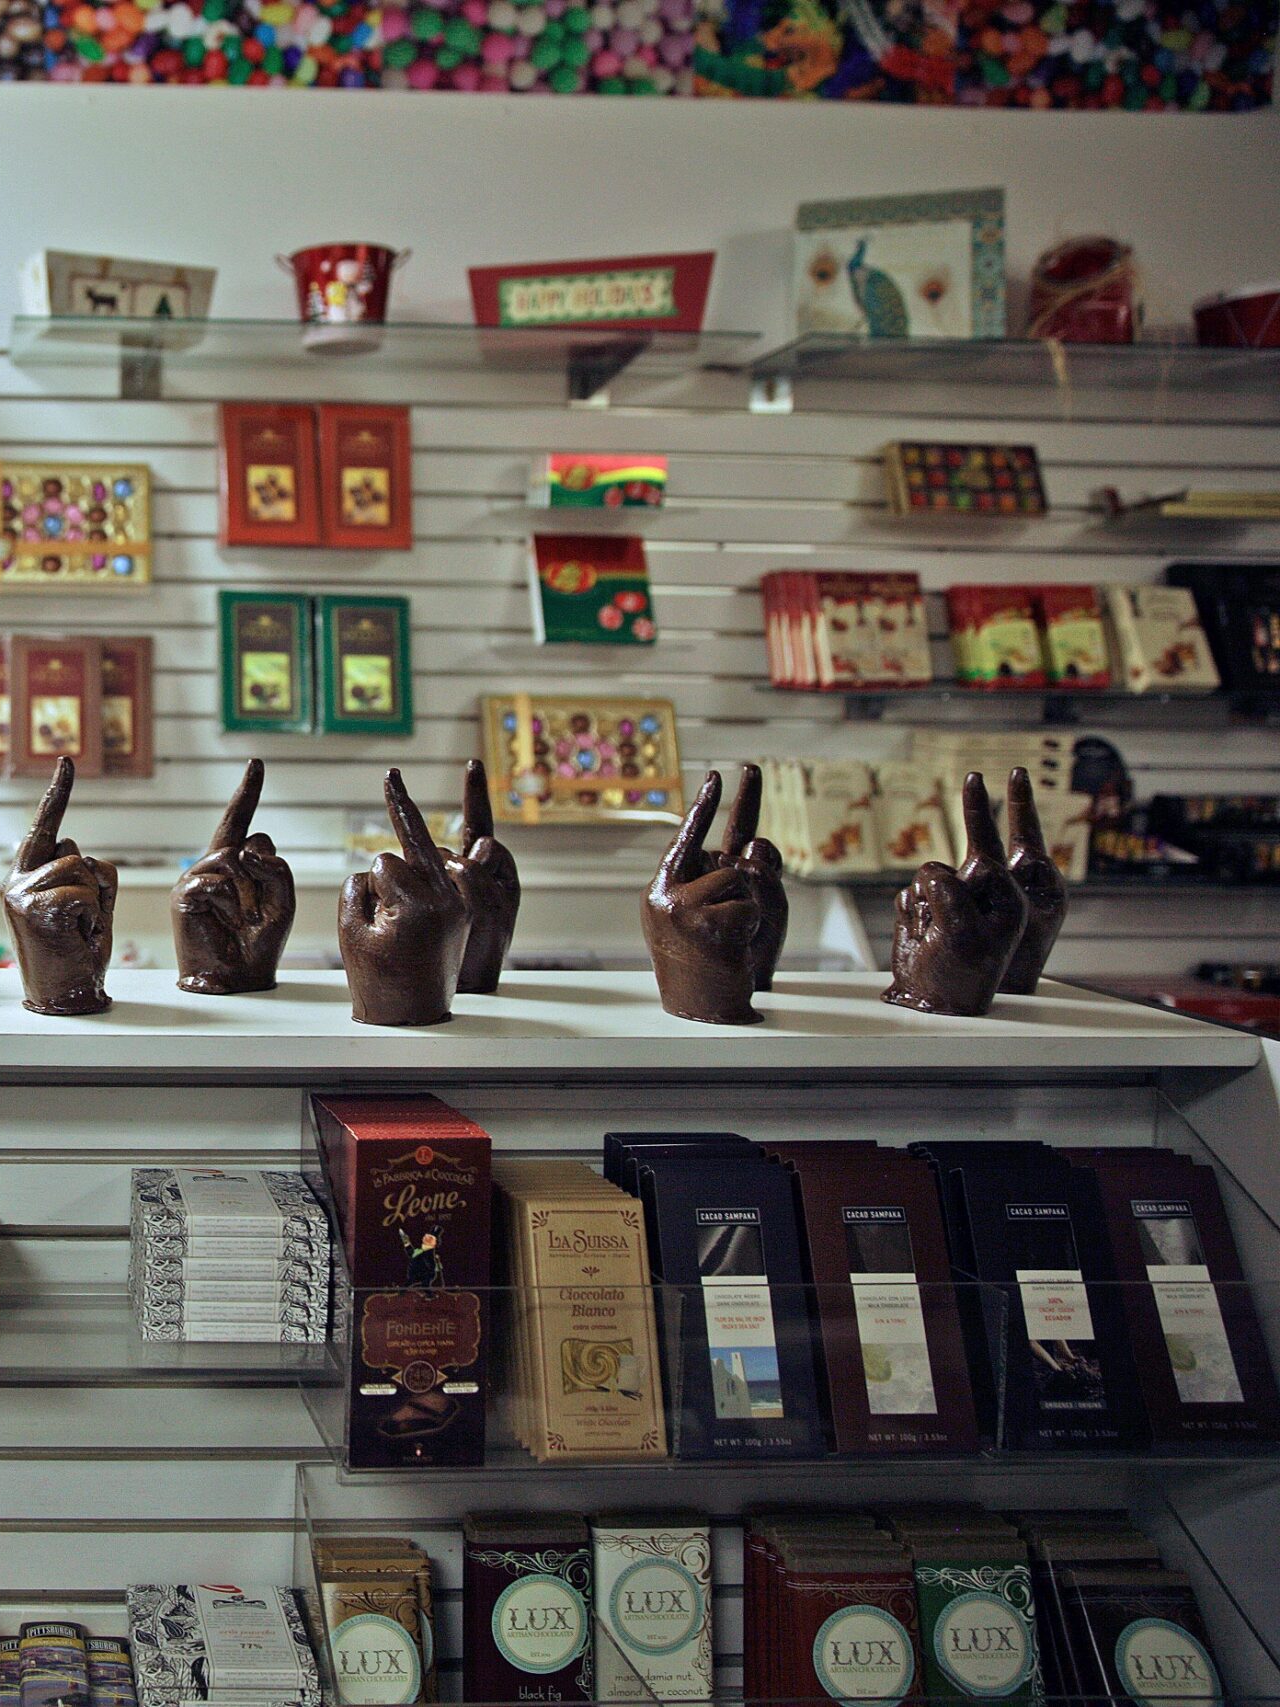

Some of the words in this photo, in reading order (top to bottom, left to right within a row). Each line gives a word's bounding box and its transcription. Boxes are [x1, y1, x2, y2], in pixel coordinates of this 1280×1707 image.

[382, 1184, 467, 1227] Leone
[700, 1212, 723, 1221] CACAO
[724, 1212, 757, 1220] SAMPAKA
[846, 1211, 869, 1219] CACAO
[870, 1210, 902, 1219] SAMPAKA
[1010, 1207, 1033, 1216] CACAO
[1034, 1207, 1066, 1216] SAMPAKA
[548, 1230, 571, 1249] LA
[573, 1229, 629, 1253] SUISSA
[572, 1304, 616, 1317] Bianco
[386, 1318, 457, 1339] FONDENTE
[624, 1590, 690, 1613] LUX
[508, 1607, 574, 1631] LUX
[949, 1626, 1018, 1651] LUX
[338, 1650, 408, 1674] LUX
[830, 1641, 901, 1665] LUX
[615, 1668, 673, 1680] macdamia
[1130, 1654, 1209, 1681] LUX
[519, 1685, 545, 1700] black
[547, 1685, 562, 1702] fig
[607, 1684, 643, 1697] almond
[667, 1687, 704, 1696] coconut
